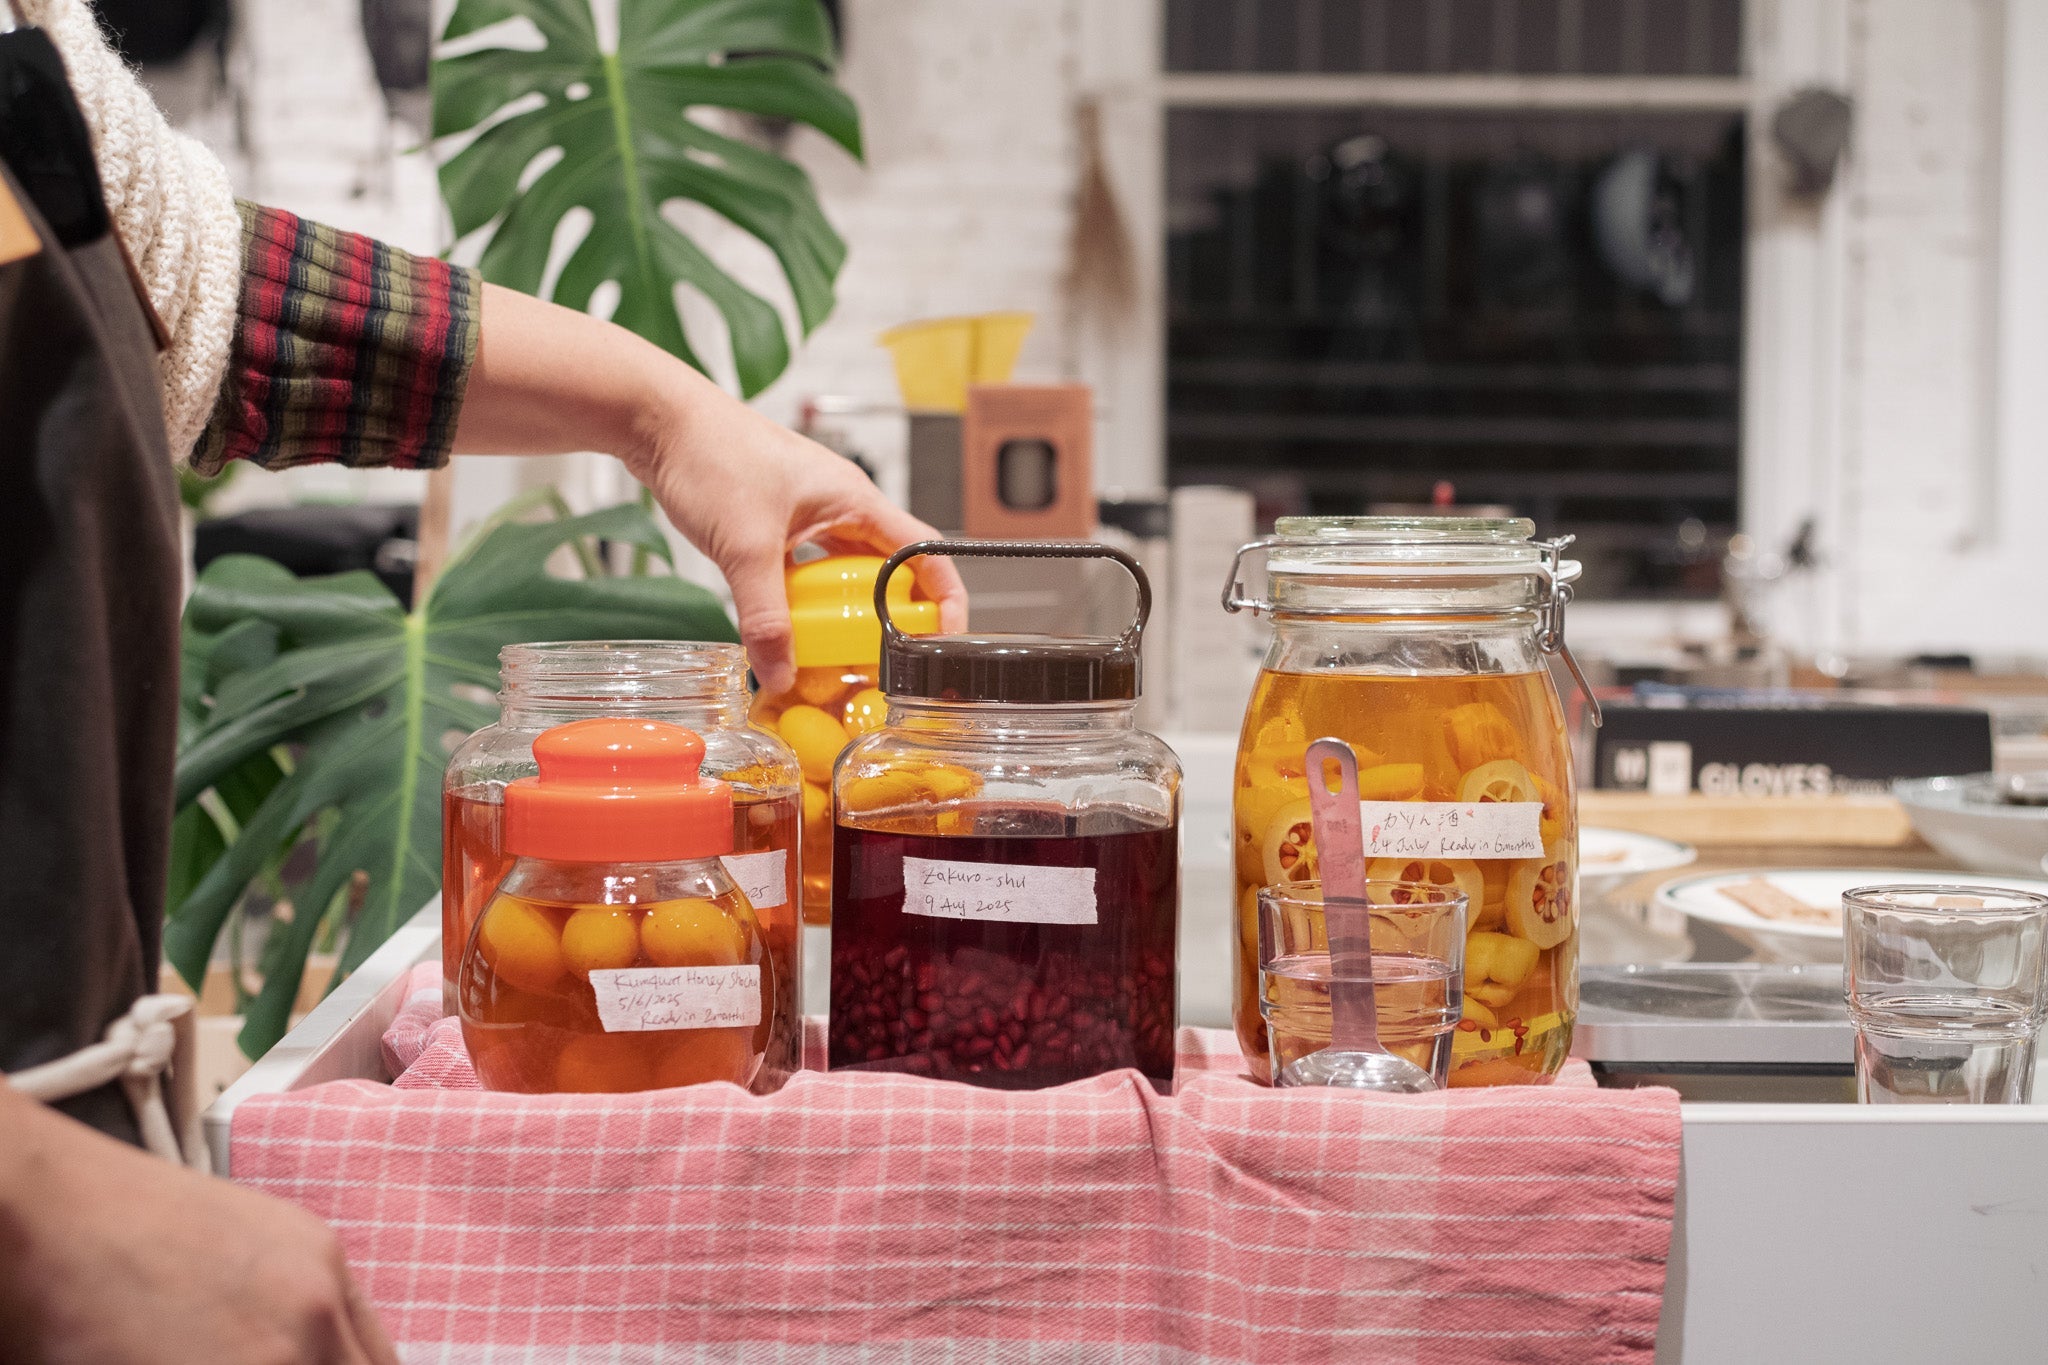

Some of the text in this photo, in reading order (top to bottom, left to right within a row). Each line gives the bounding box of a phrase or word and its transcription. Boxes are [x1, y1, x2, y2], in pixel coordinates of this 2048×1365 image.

[1700, 762, 1833, 798] GLOVES
[1396, 836, 1430, 854] July
[1440, 836, 1476, 855] Ready
[1479, 839, 1489, 851] in
[925, 895, 1013, 916] 9 Aug 2025
[687, 971, 726, 994] Honey
[641, 1010, 682, 1029] Ready
[684, 1011, 696, 1022] in
